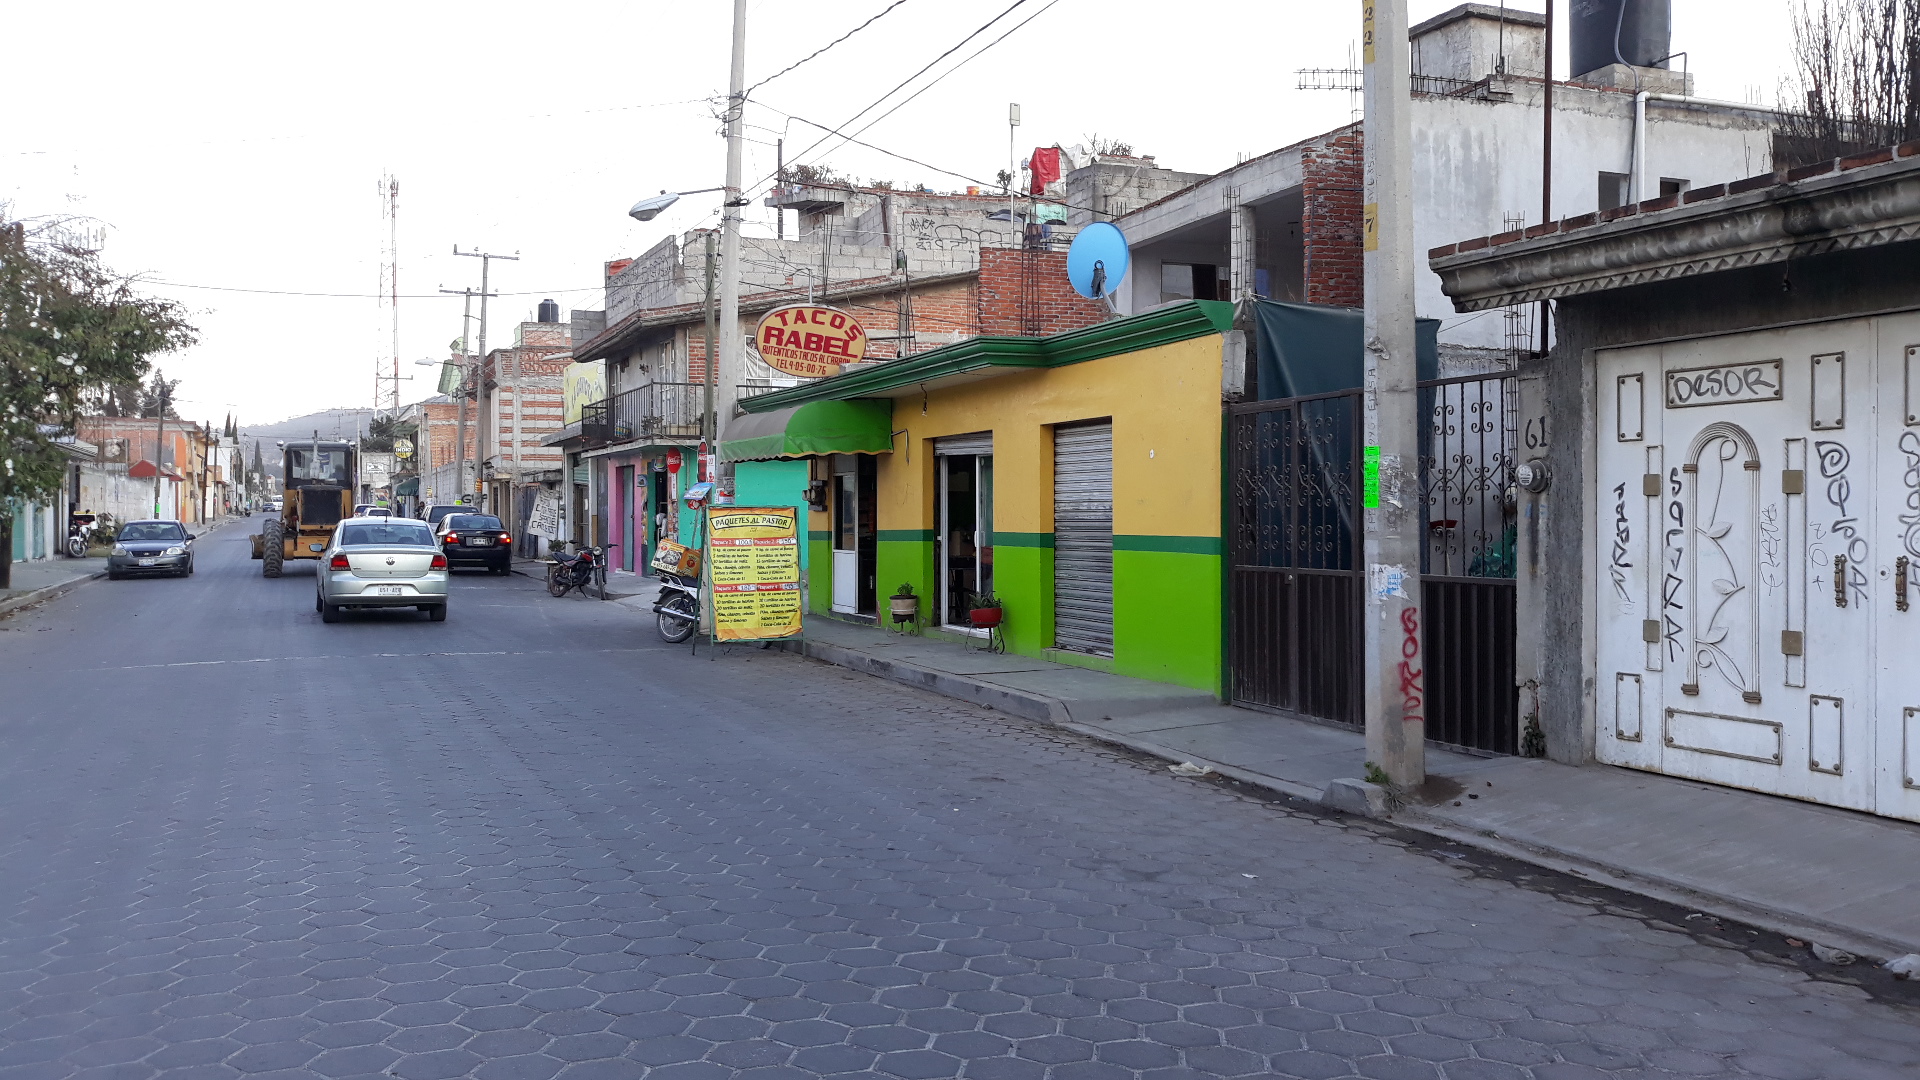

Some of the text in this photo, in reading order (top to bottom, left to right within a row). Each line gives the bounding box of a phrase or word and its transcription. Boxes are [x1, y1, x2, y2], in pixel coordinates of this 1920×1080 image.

[774, 310, 862, 342] TACOS
[762, 345, 798, 360] AUTENTICOS
[799, 350, 818, 363] TACOS
[819, 354, 826, 364] AL
[763, 326, 858, 358] RABEL
[776, 358, 788, 370] TEL
[1525, 416, 1548, 450] 61
[716, 517, 750, 526] PAQUETES
[762, 517, 788, 526] PASTOR
